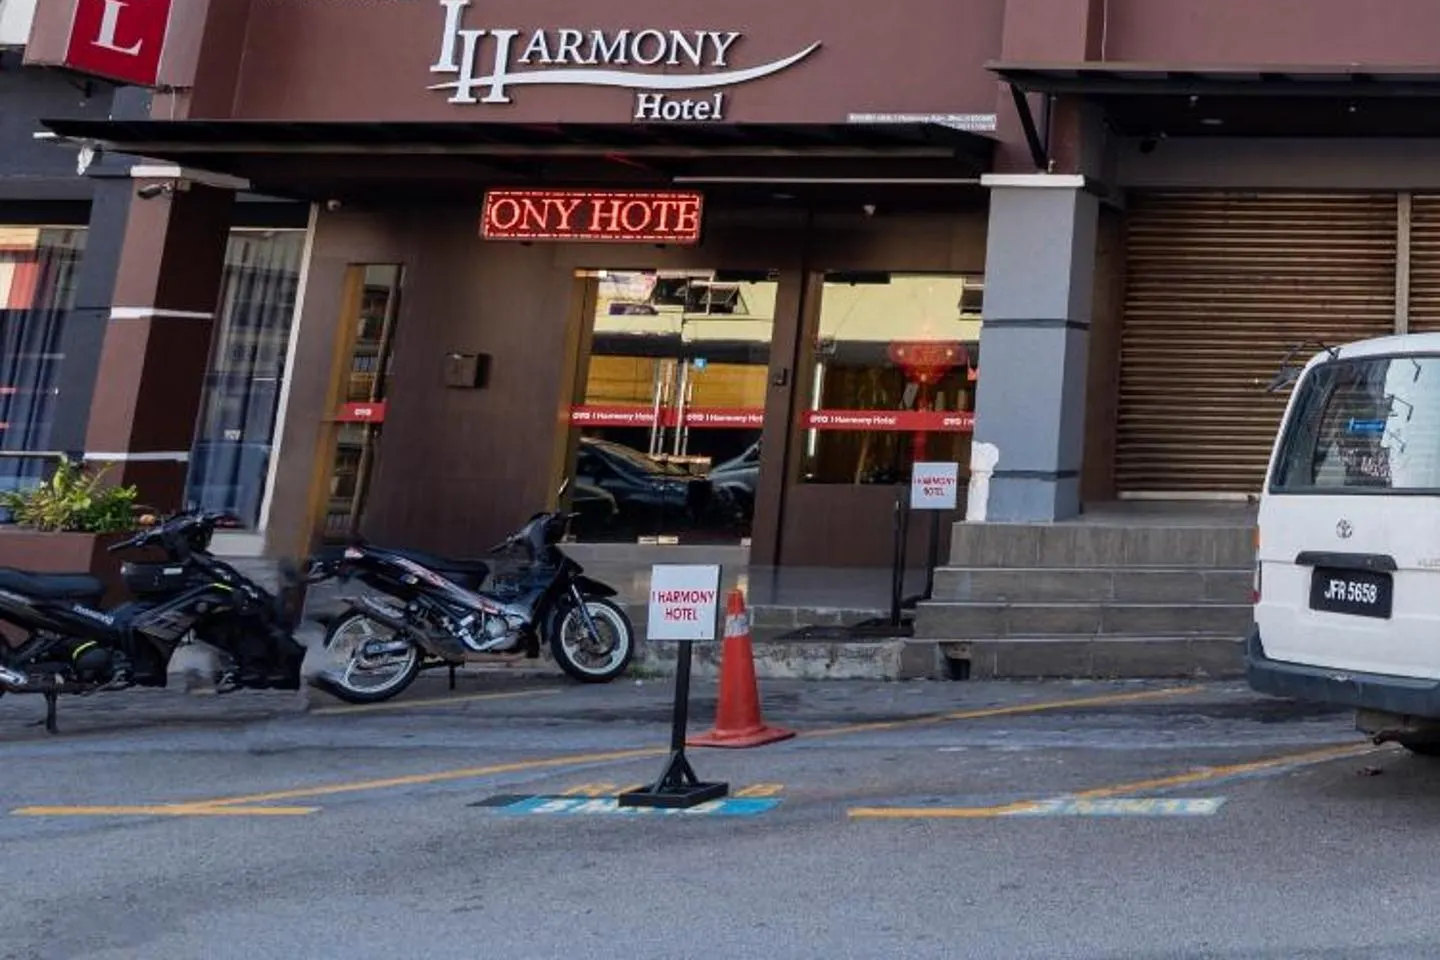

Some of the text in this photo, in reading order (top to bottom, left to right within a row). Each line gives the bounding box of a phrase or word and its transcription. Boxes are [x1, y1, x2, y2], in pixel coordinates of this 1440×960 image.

[635, 93, 724, 120] Hotel
[490, 199, 699, 232] ONY HOTE
[658, 590, 715, 604] HARMONY
[1324, 579, 1346, 601] JFR
[665, 608, 698, 621] HOTEL
